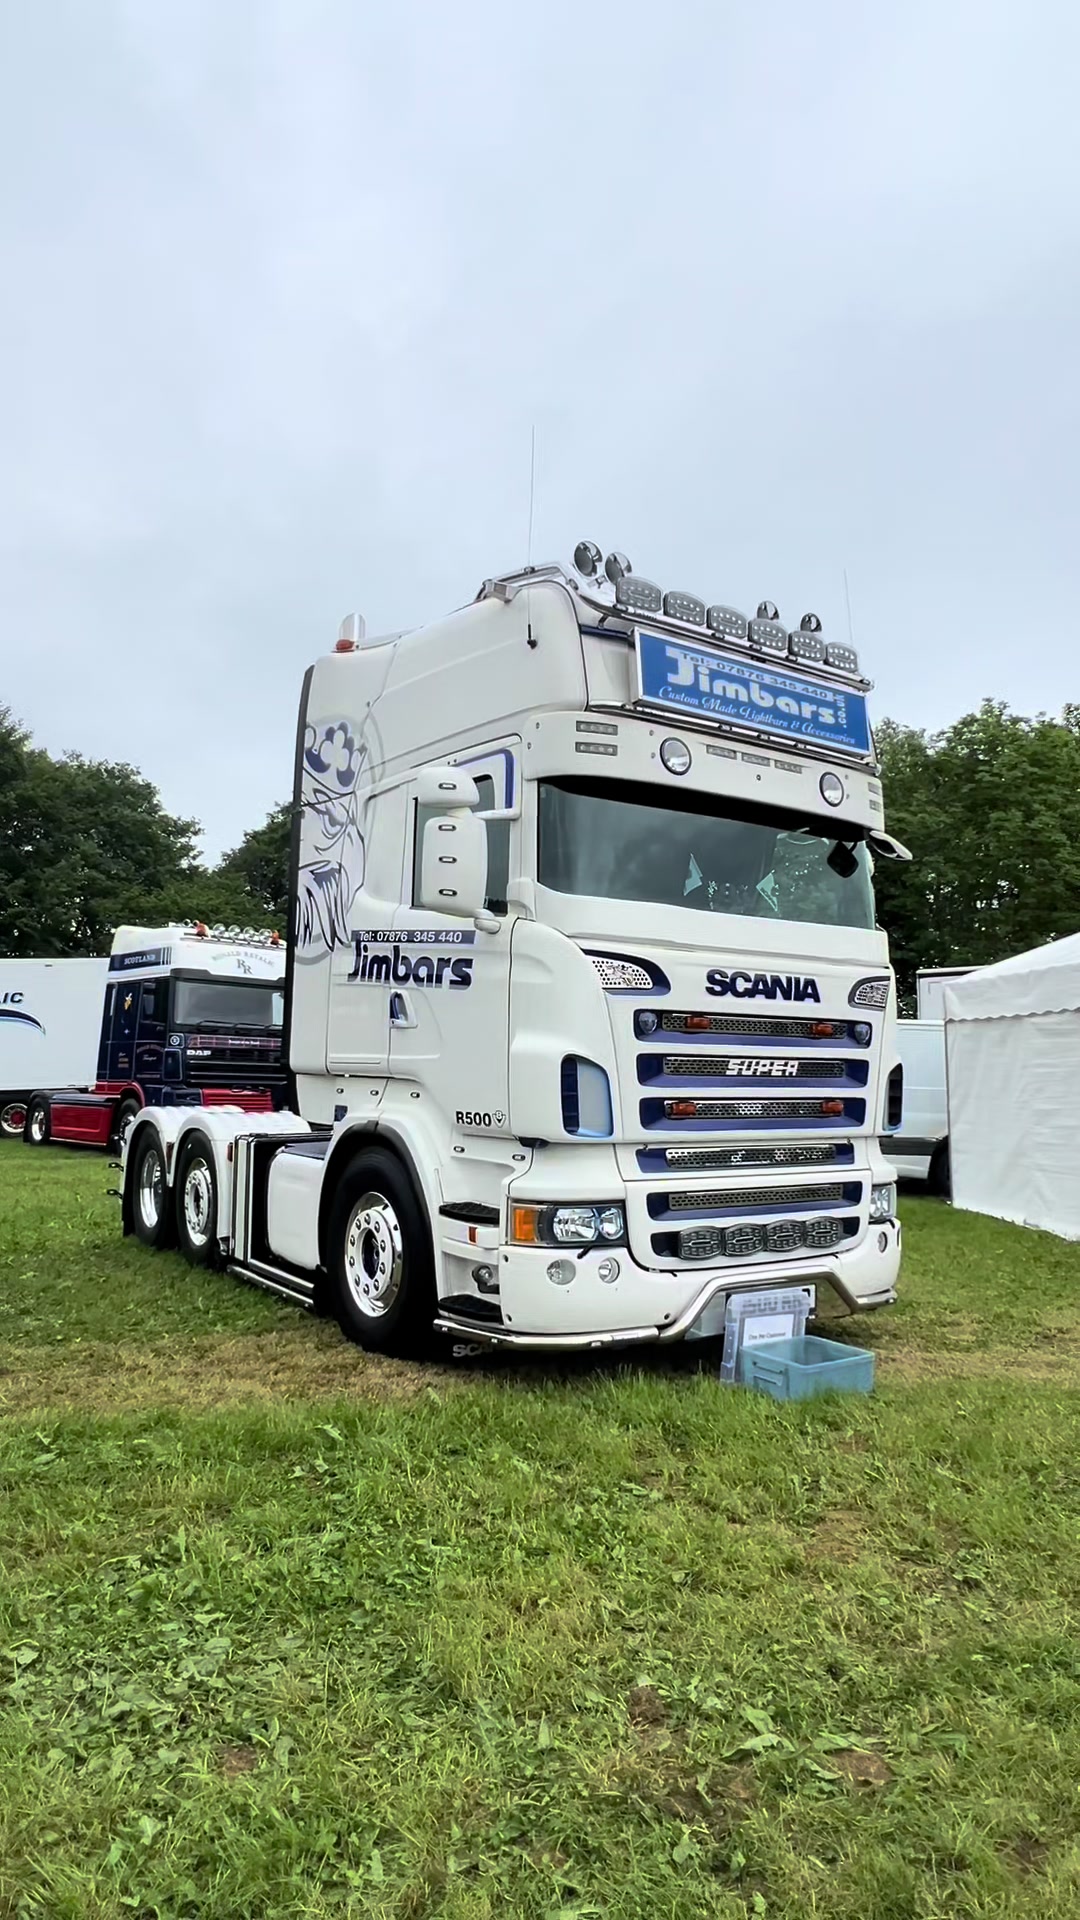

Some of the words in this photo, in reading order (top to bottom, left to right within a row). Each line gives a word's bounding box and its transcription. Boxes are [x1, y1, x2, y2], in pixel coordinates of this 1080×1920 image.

[665, 645, 836, 725] Jimbars
[682, 652, 711, 667] Tel:
[717, 662, 765, 681] 07876
[769, 677, 798, 690] 345
[802, 686, 828, 698] 440
[659, 685, 699, 705] Custom
[702, 696, 737, 715] Made
[791, 720, 800, 730] &
[359, 931, 375, 942] Tel:
[377, 931, 409, 942] 07876
[413, 931, 436, 943] 345
[438, 932, 462, 943] 440
[124, 954, 156, 965] SCOTLAND
[347, 940, 474, 990] Jimbars
[0, 992, 24, 1004] IC
[705, 969, 821, 1003] SCANIA
[726, 1060, 799, 1076] SUPER
[455, 1110, 492, 1127] R500
